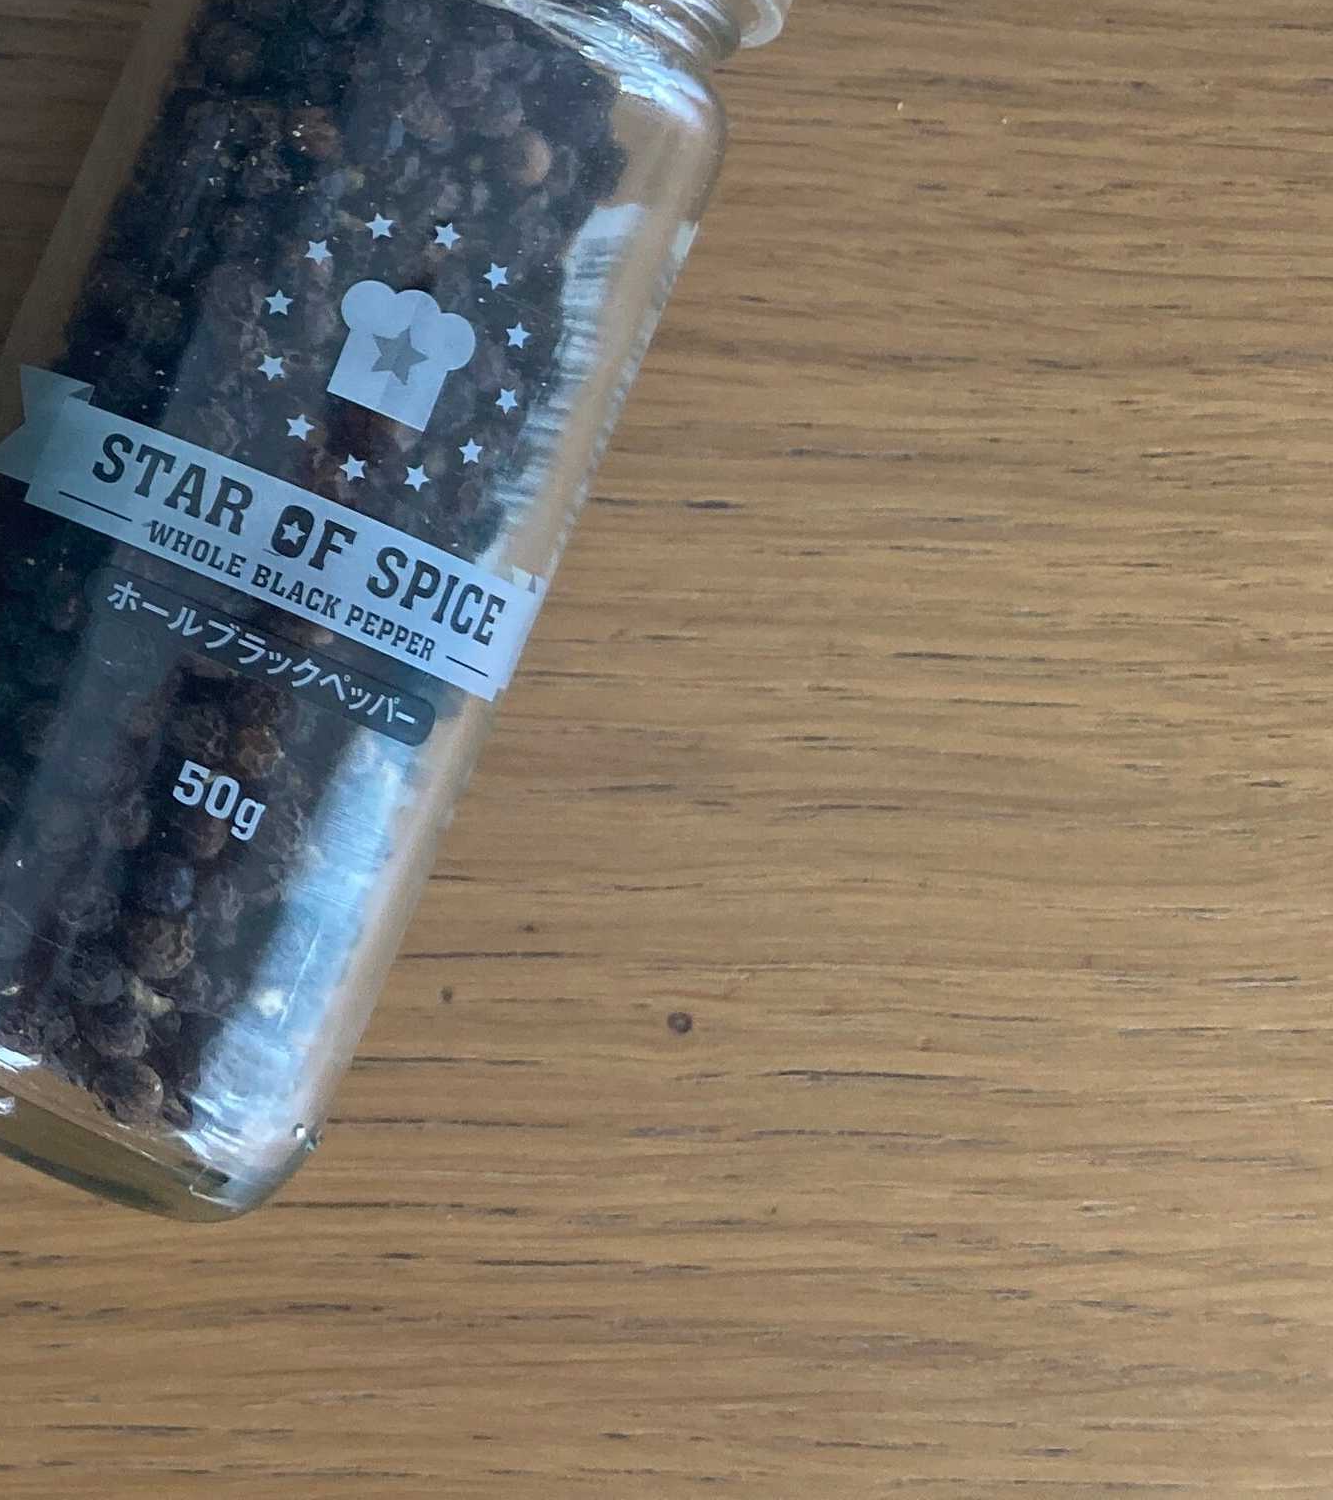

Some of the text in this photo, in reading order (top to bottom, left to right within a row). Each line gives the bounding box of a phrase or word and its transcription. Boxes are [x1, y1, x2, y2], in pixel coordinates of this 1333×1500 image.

[92, 432, 507, 647] STAR OF SPICE
[146, 520, 436, 662] WHOLE BLACK PEPPER
[107, 581, 416, 724] ホールブラックペッパー
[172, 760, 266, 843] 50g
